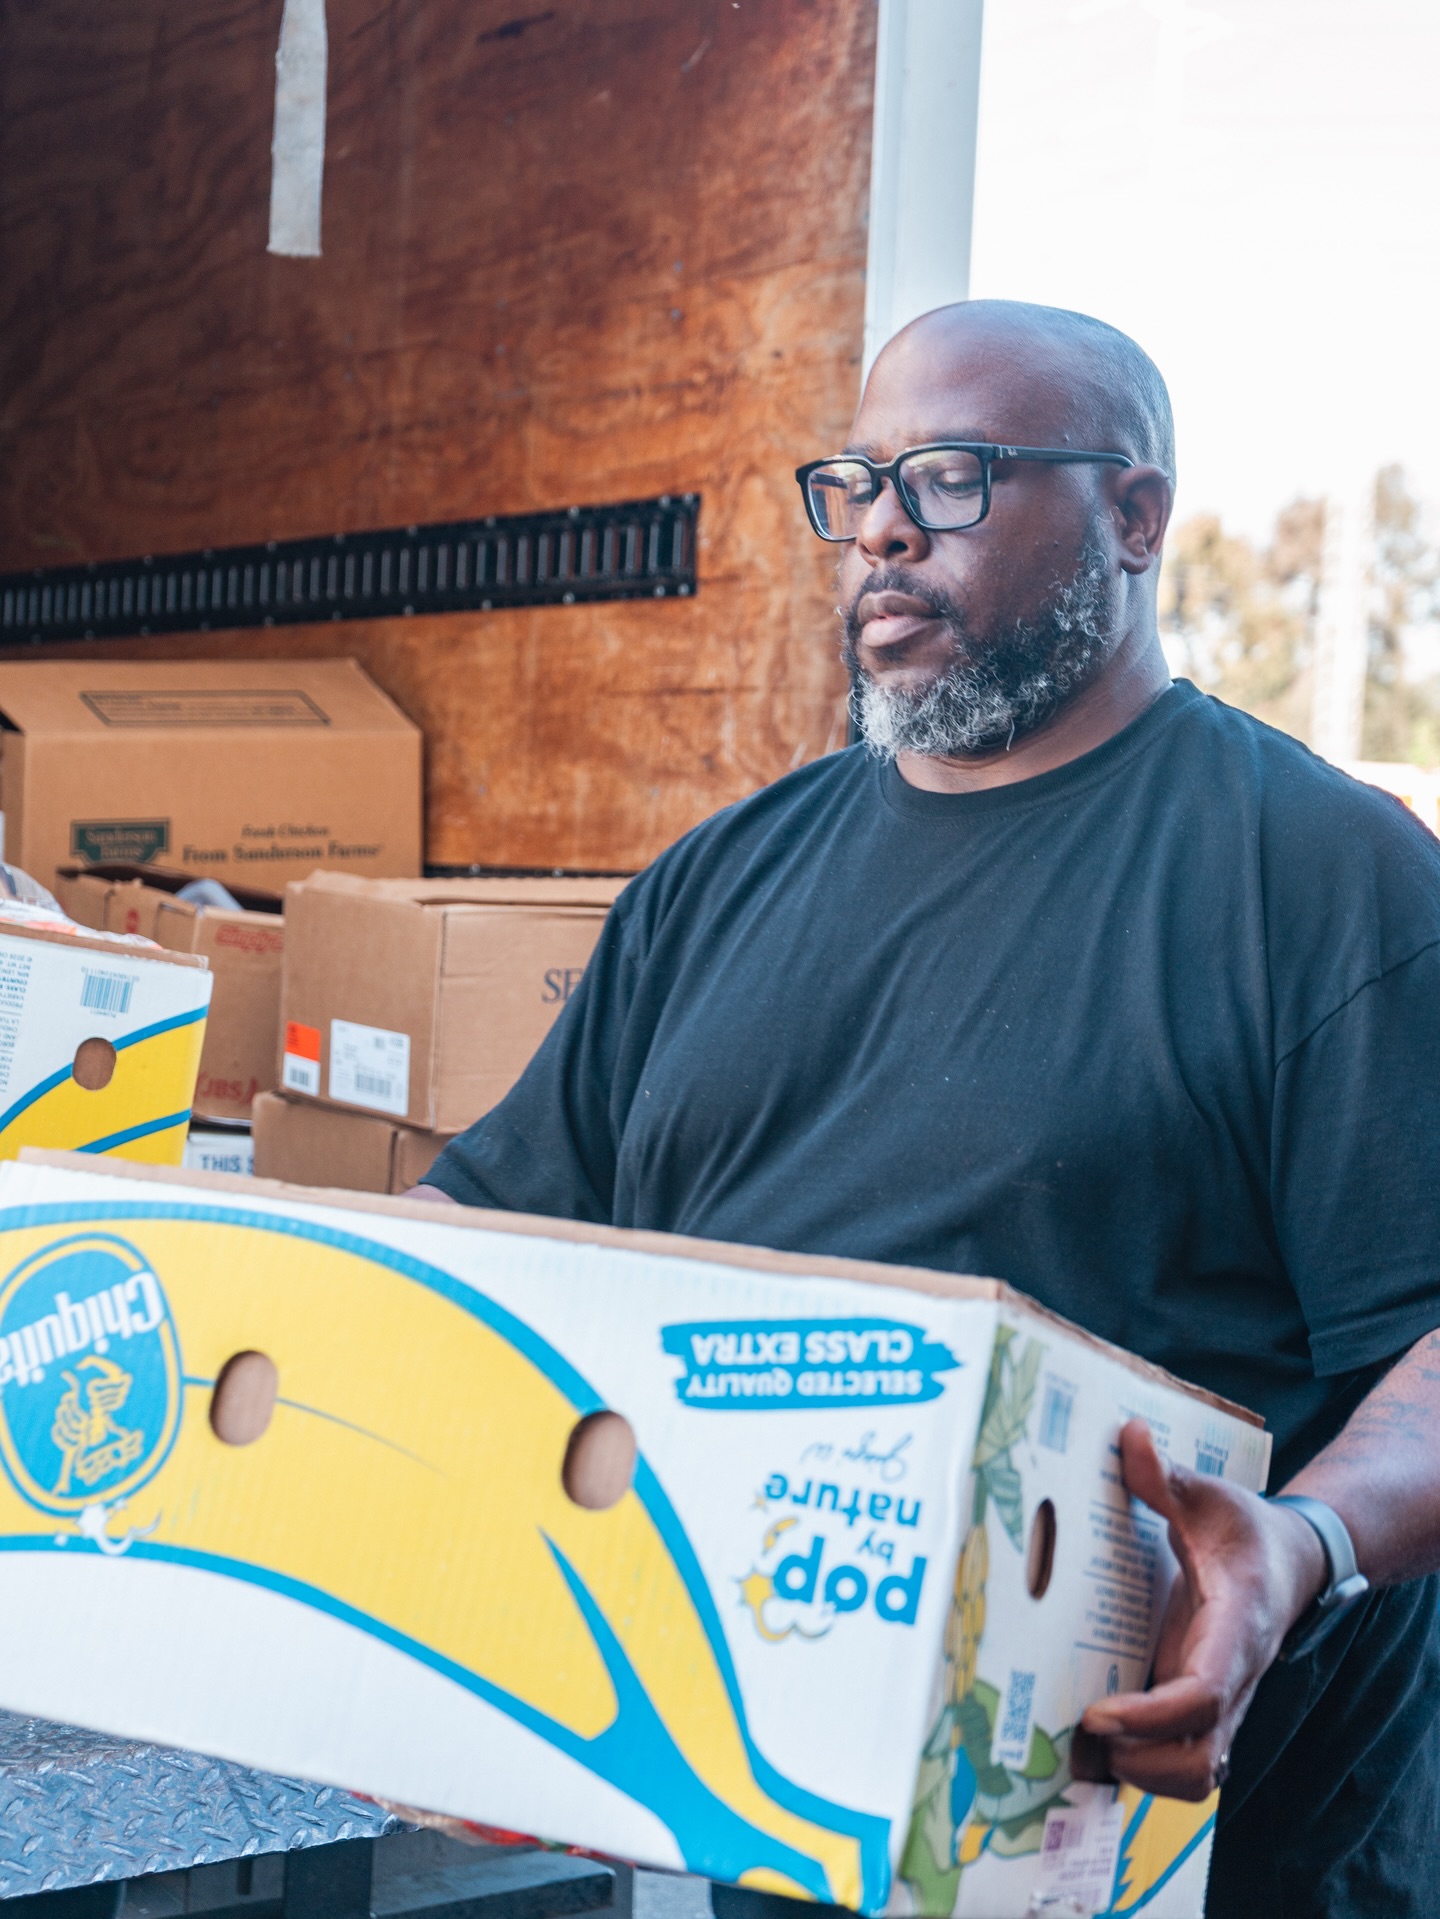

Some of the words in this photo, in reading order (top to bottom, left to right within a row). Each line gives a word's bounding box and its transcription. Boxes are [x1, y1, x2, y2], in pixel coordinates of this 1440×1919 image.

[182, 845, 228, 863] From
[233, 842, 322, 861] Sanderson
[200, 1154, 242, 1174] THIS
[690, 1332, 800, 1365] EXTRA
[805, 1329, 914, 1363] CLASS
[685, 1367, 794, 1397] QUALITY
[796, 1369, 923, 1396] SELECTED
[764, 1474, 921, 1527] nature
[858, 1531, 896, 1564] by
[772, 1536, 927, 1625] pop
